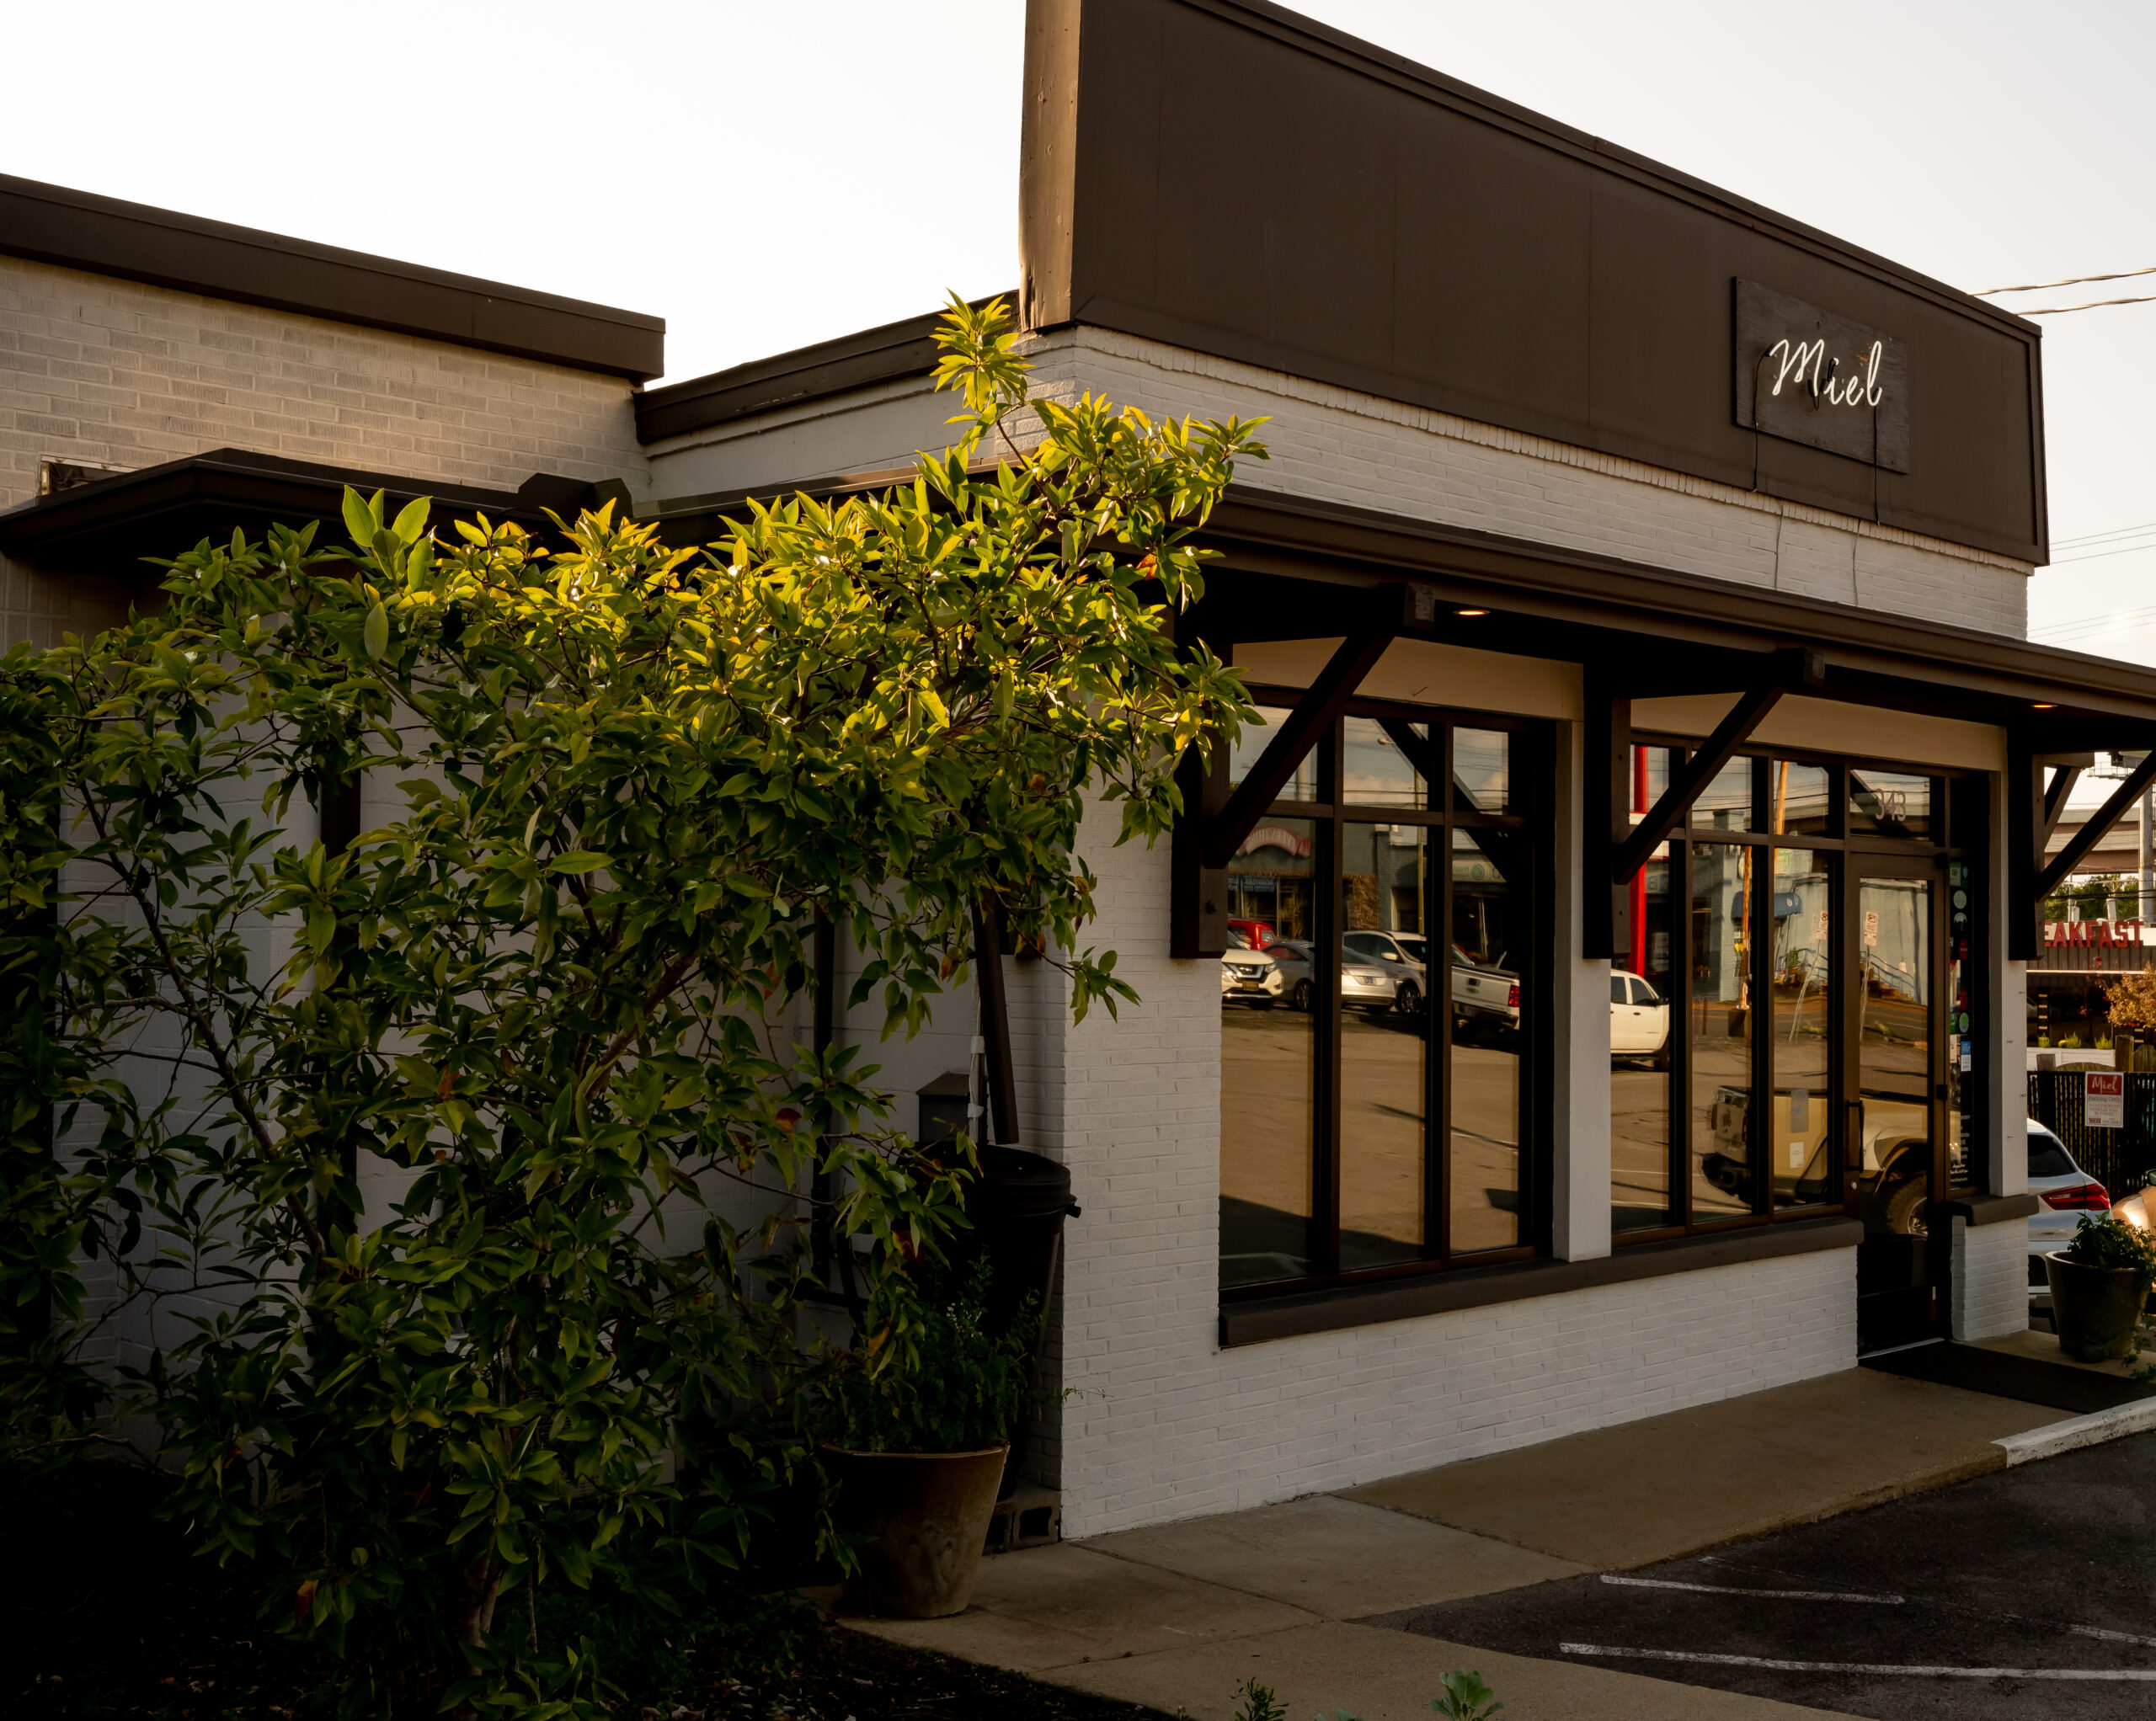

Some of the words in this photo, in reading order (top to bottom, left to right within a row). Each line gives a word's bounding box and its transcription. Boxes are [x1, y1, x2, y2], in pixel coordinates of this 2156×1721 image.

[1769, 338, 1883, 407] Miel
[1876, 788, 1907, 822] 343
[2091, 1075, 2118, 1094] Miel
